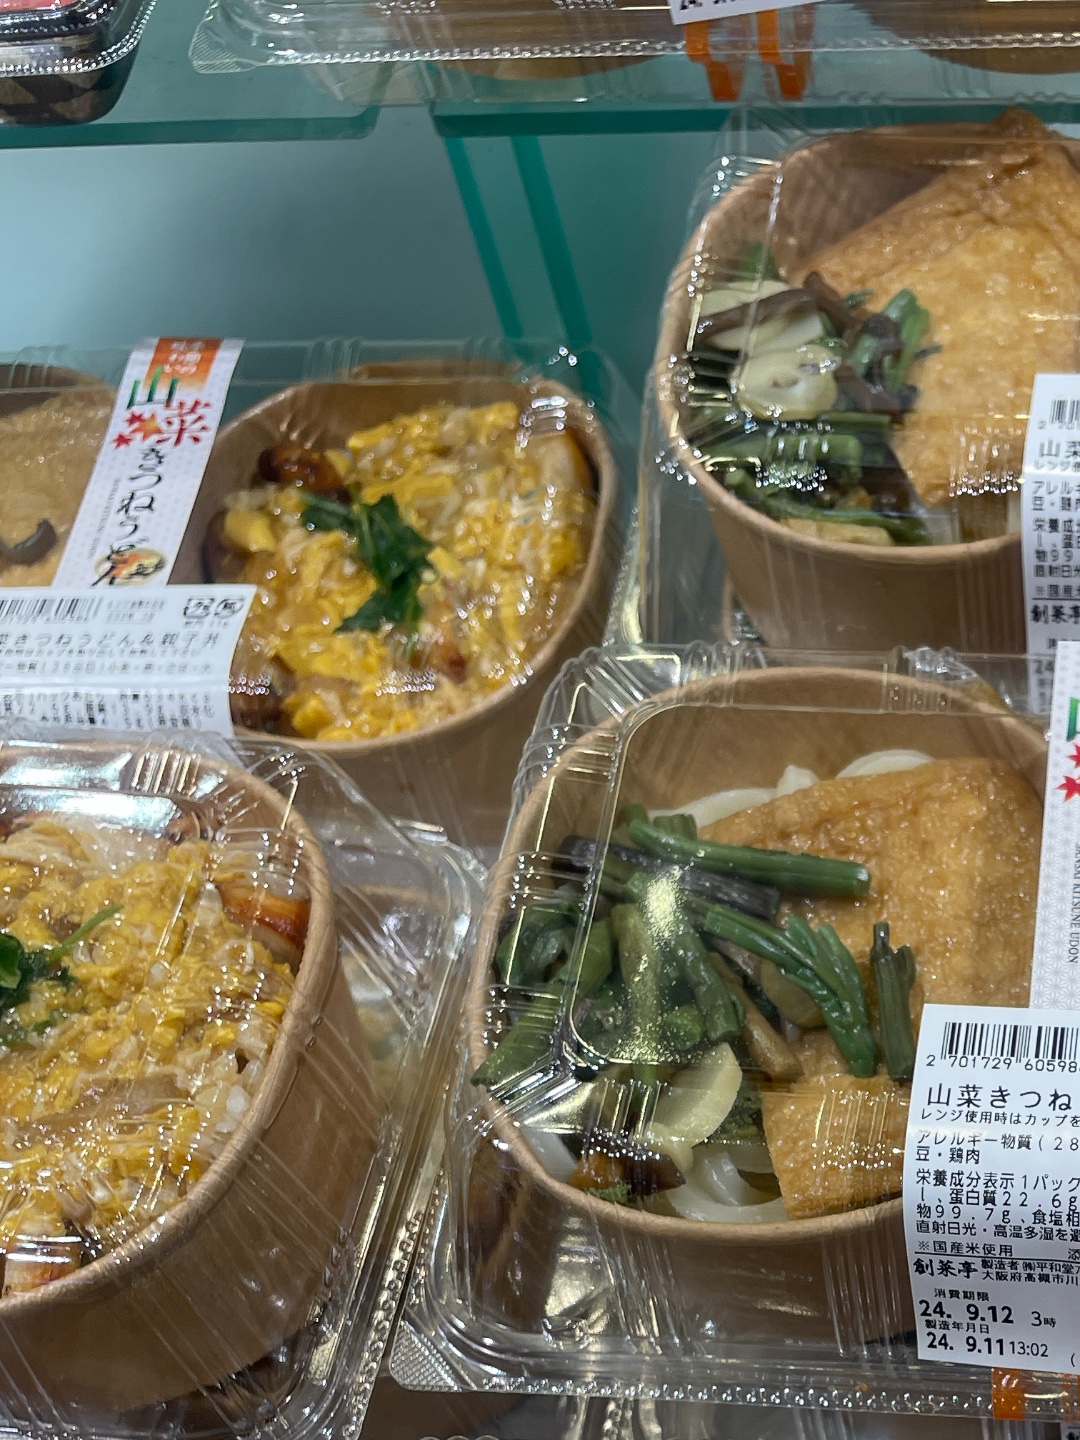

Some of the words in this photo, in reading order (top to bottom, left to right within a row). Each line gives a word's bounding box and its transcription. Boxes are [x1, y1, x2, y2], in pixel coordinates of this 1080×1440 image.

[926, 1054, 936, 1067] 2
[950, 1055, 1012, 1070] 701729
[915, 1145, 980, 1165] 豆・鶏肉
[933, 1287, 990, 1302] 消費期限
[924, 1318, 990, 1334] 製造年月日
[1031, 1310, 1057, 1328] 3時
[1008, 1340, 1049, 1358] 13:02
